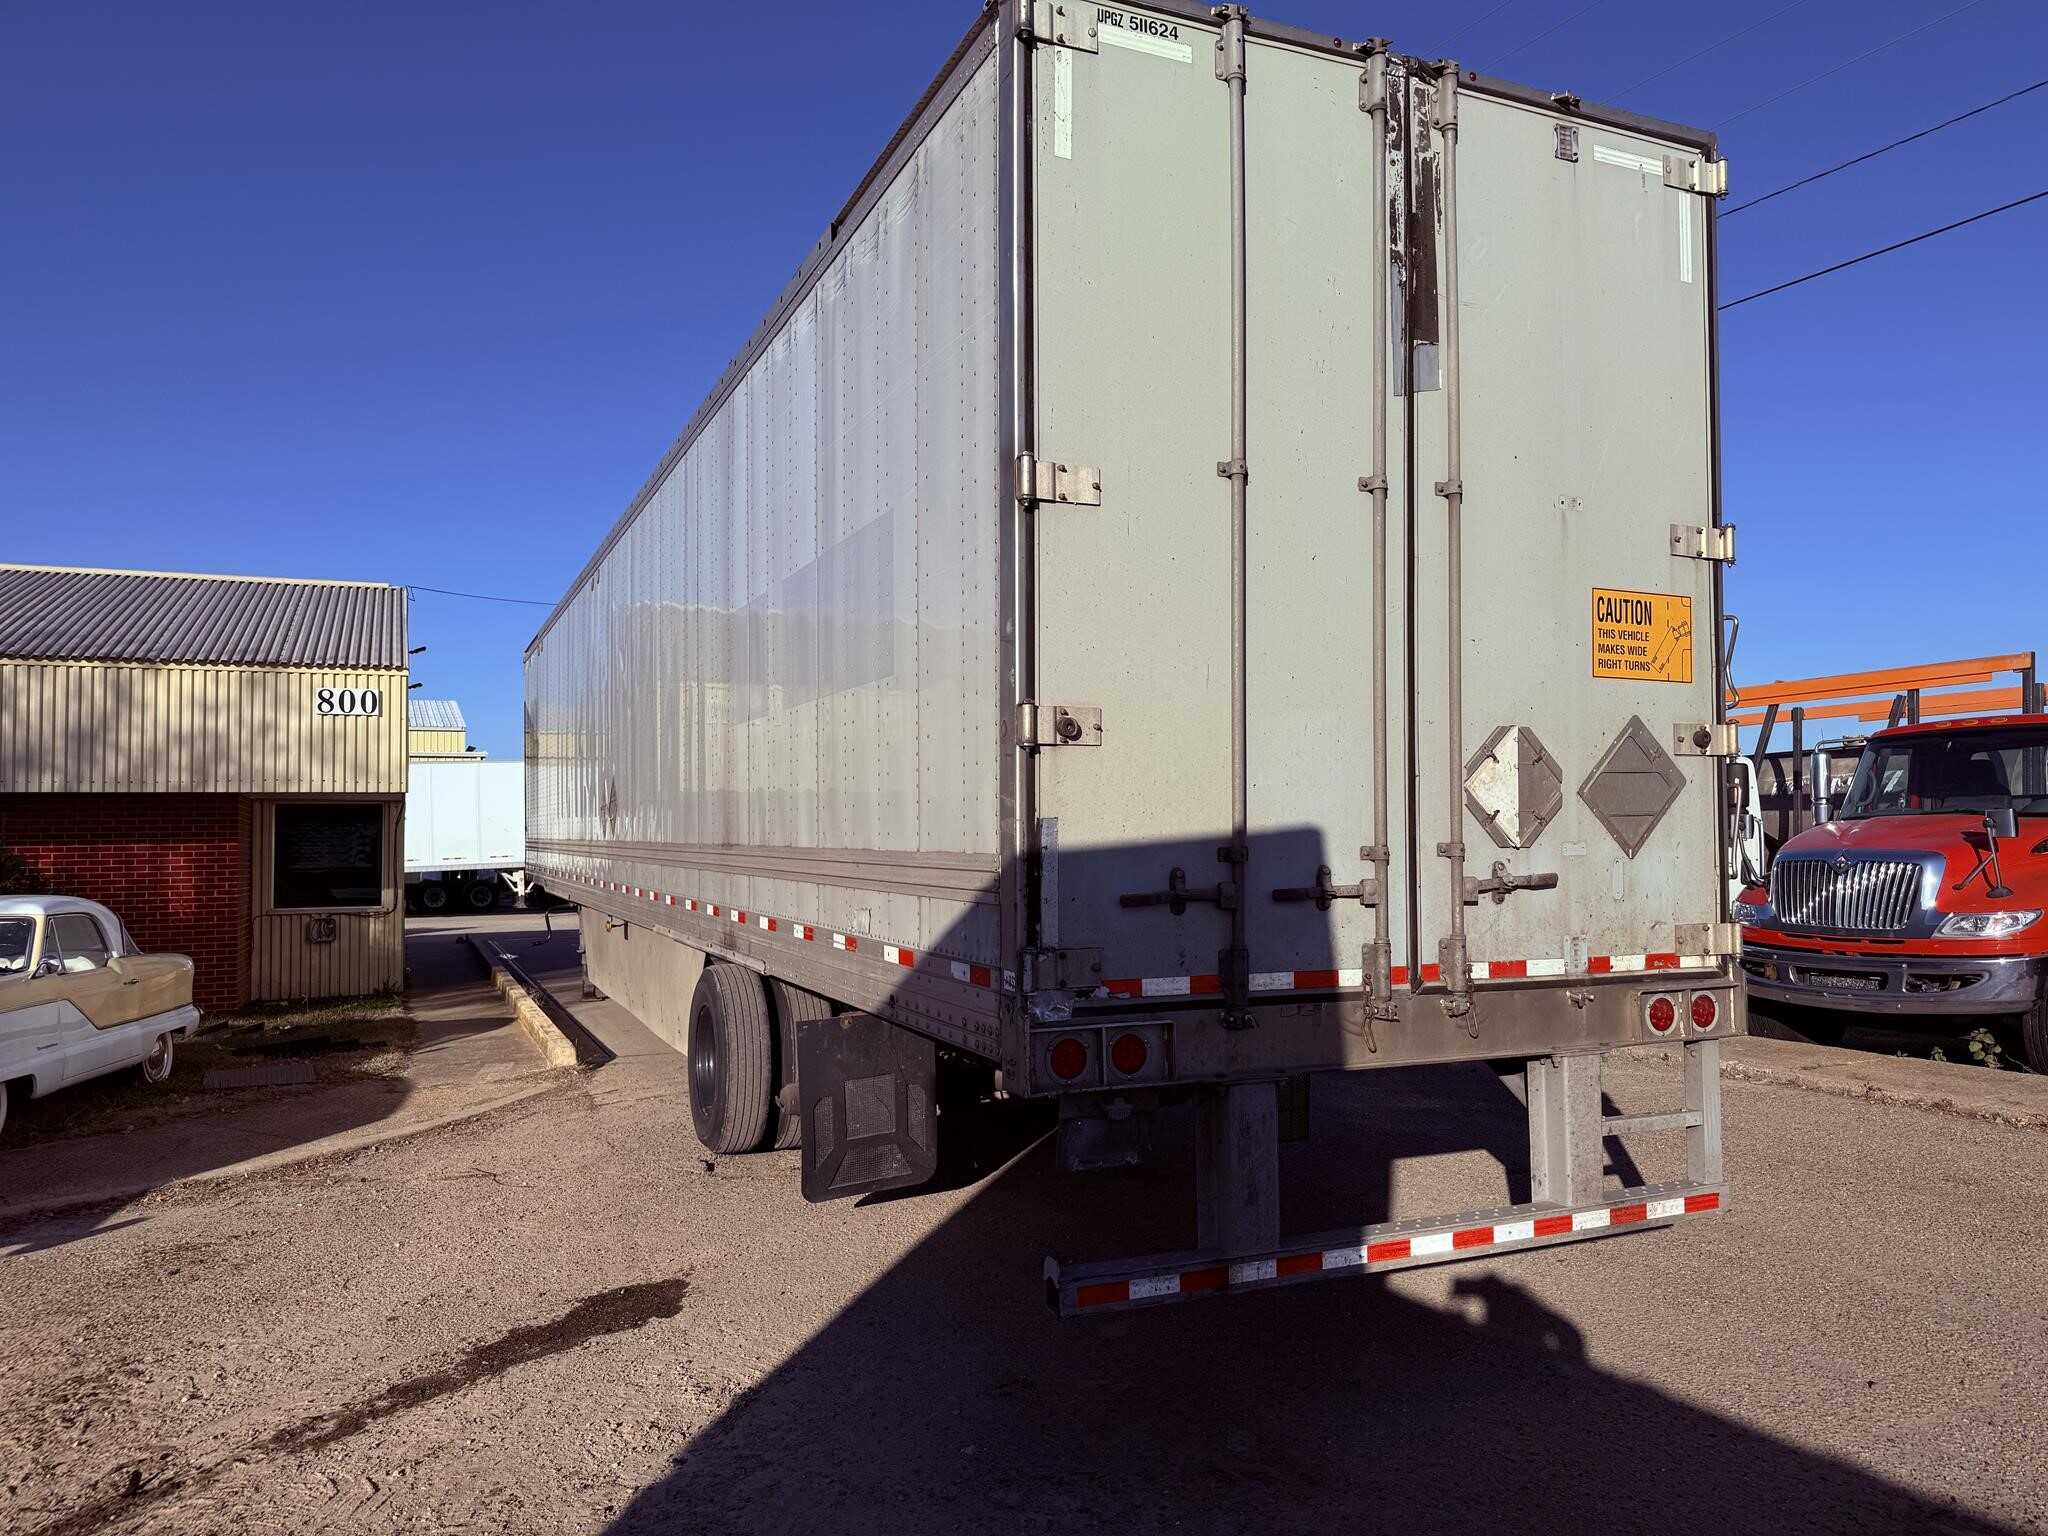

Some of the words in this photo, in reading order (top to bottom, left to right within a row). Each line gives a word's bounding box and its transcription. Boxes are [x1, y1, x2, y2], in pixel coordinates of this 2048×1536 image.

[1097, 8, 1124, 28] UPGZ
[1129, 15, 1179, 40] 511624
[1597, 596, 1652, 626] CAUTION
[1598, 628, 1616, 640] THIS
[1618, 630, 1650, 642] VEHICLE
[1598, 643, 1625, 655] MAKES
[1627, 645, 1648, 656] WIDE
[1598, 658, 1622, 670] RIGHT
[1625, 660, 1651, 672] TURNS
[317, 688, 378, 714] 800
